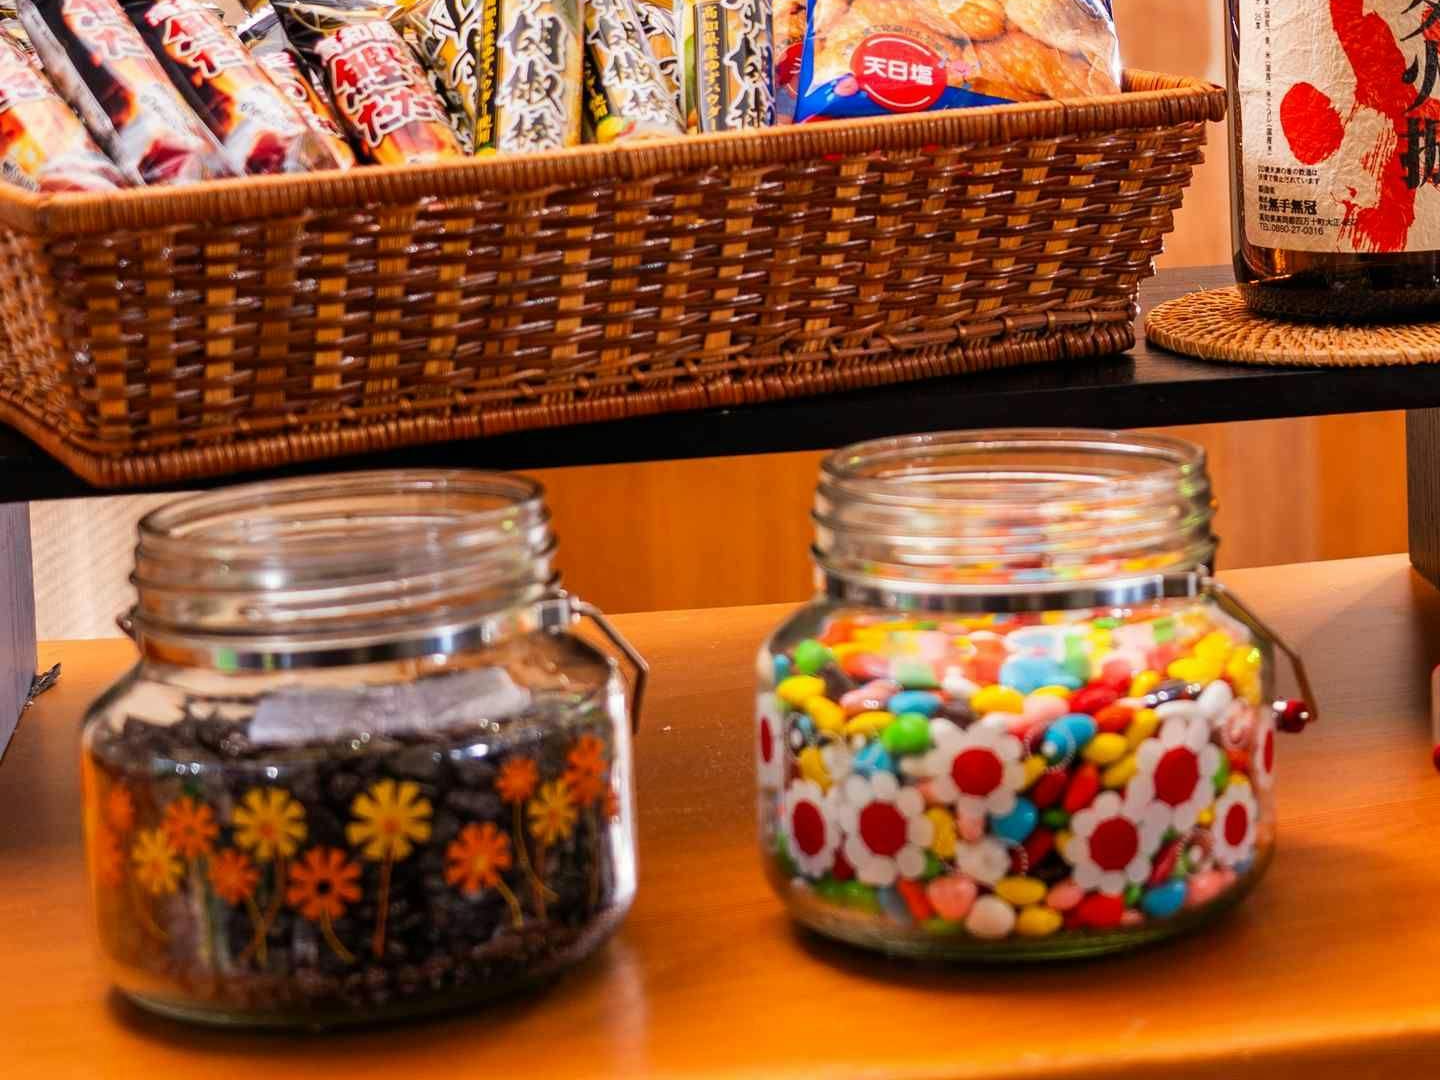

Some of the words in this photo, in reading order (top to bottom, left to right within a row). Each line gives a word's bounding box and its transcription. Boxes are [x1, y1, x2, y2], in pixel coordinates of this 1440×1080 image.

[863, 56, 933, 85] 天日塩
[1269, 198, 1317, 215] 無手無冠
